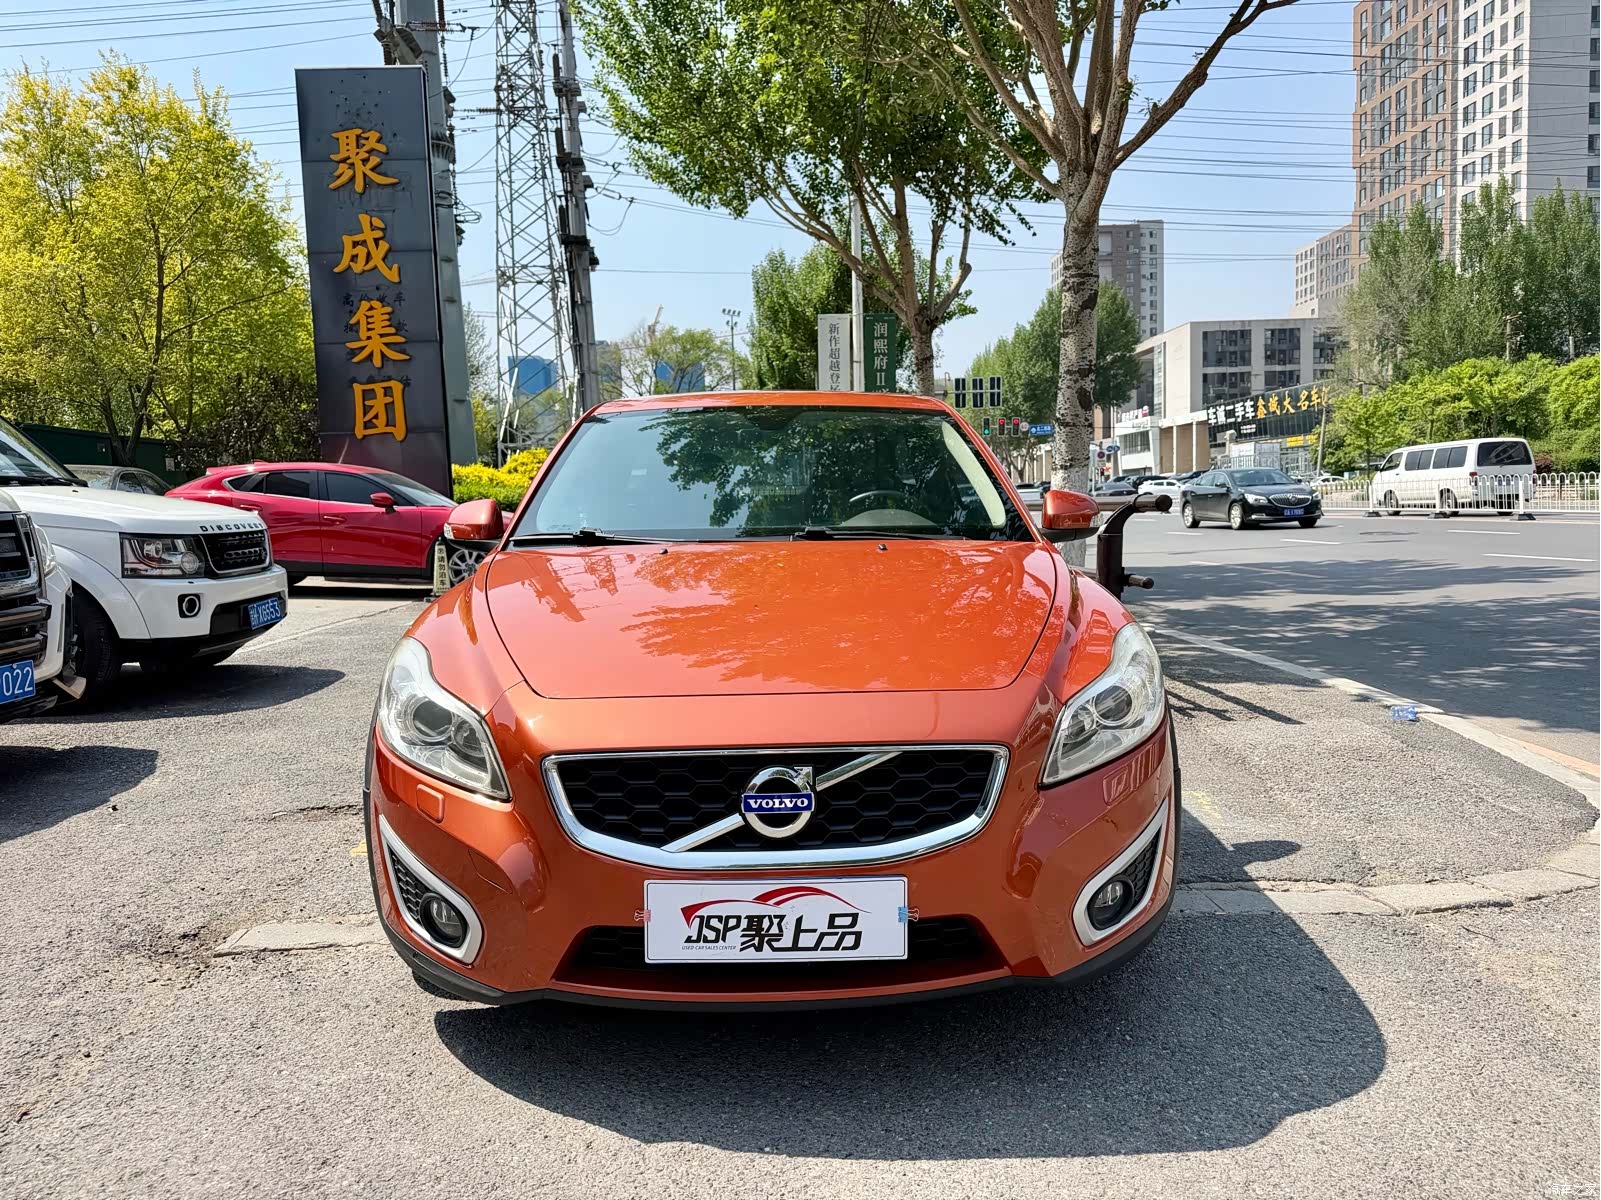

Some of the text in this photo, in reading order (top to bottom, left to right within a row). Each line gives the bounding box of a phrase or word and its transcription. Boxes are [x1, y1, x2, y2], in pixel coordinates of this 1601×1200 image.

[328, 127, 411, 441] 聚成集团
[873, 322, 889, 392] 润熙府II
[747, 798, 808, 808] VOLVO
